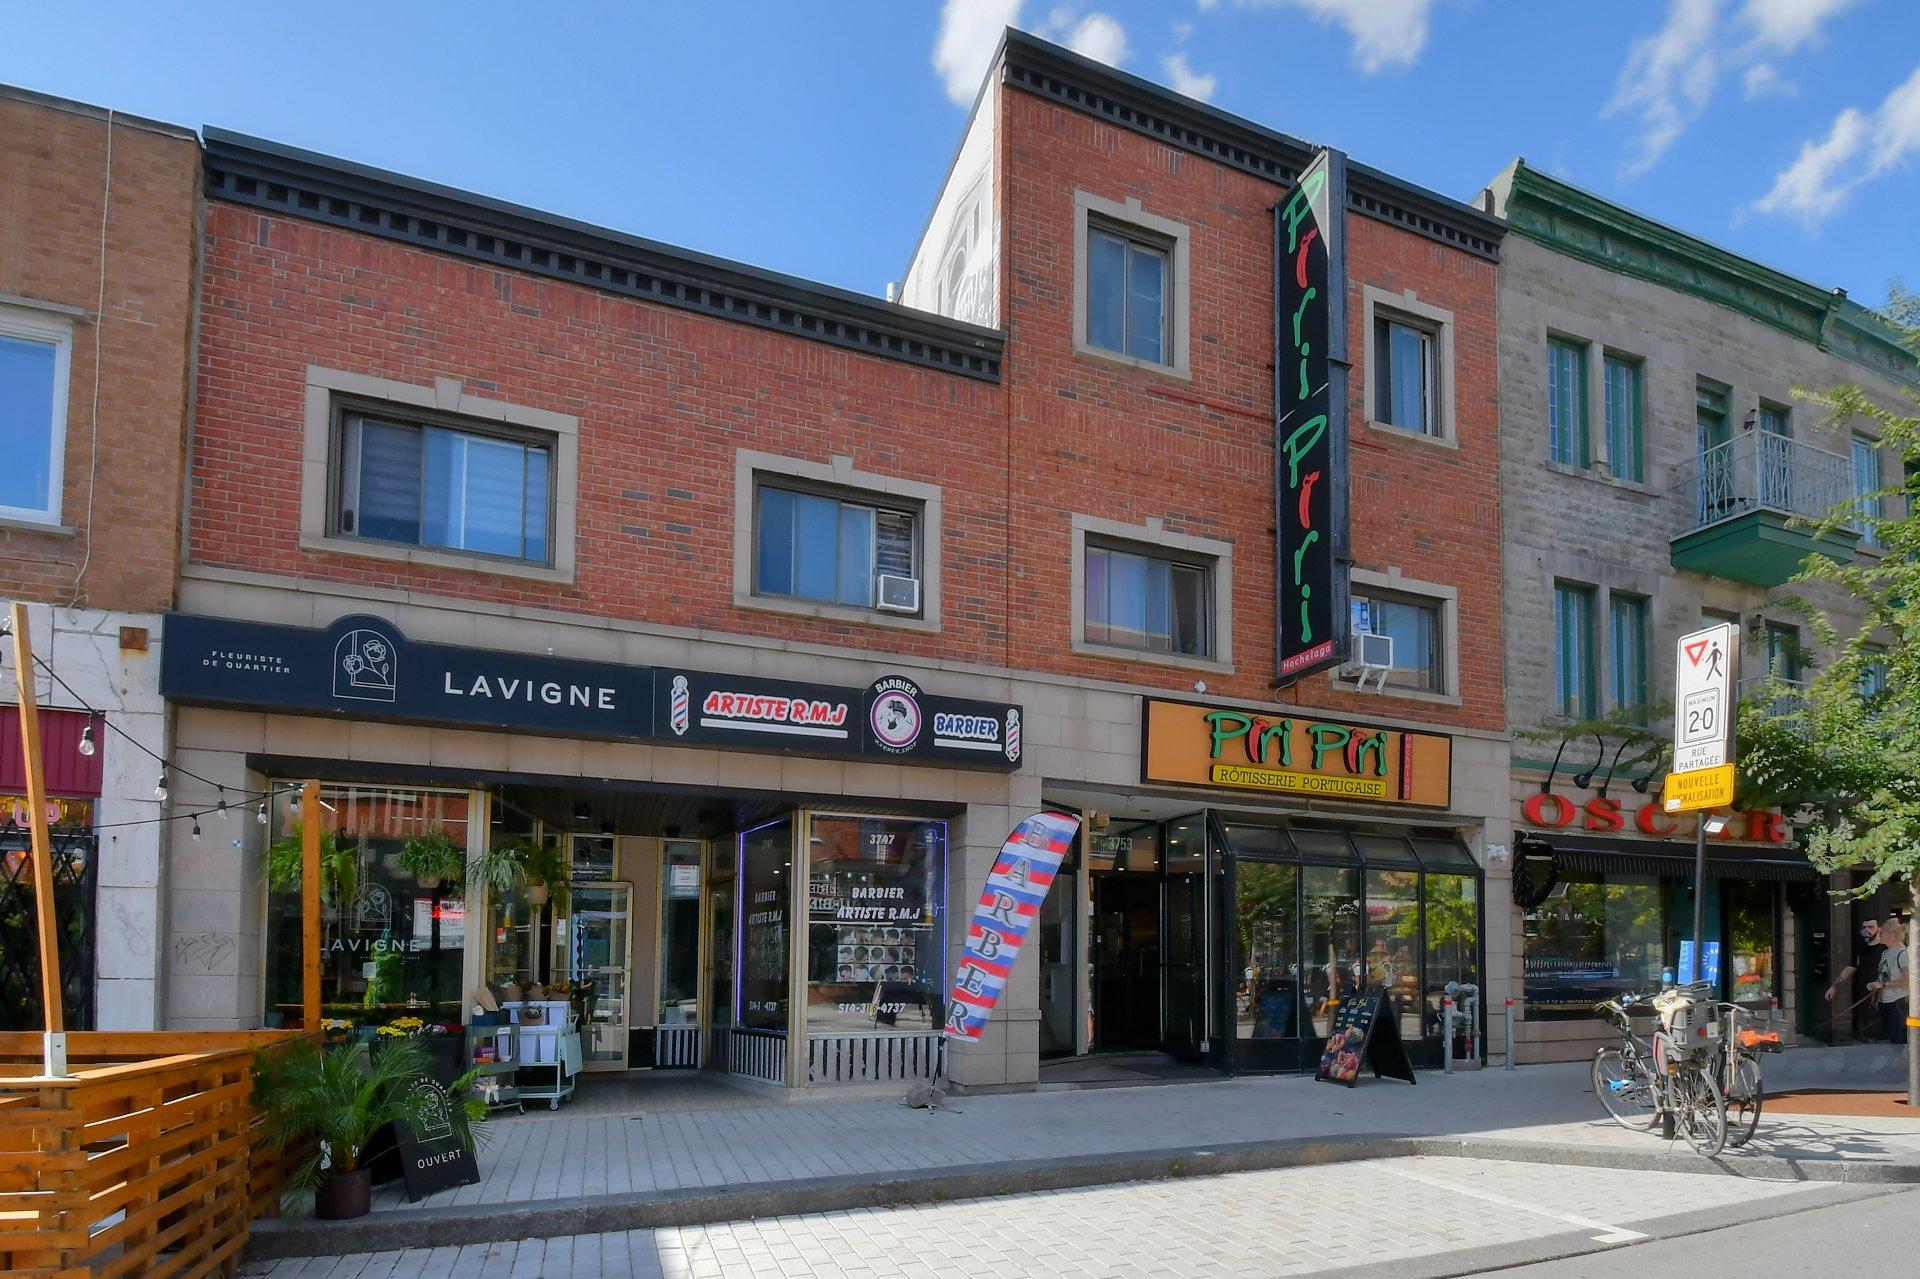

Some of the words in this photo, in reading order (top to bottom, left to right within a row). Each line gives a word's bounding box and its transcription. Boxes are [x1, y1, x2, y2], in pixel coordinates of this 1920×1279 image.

[1282, 170, 1324, 400] Piri
[1283, 415, 1327, 643] Piri
[203, 659, 218, 667] DE
[226, 661, 290, 674] QUARTIER
[212, 650, 282, 664] FLEURISTE
[1283, 645, 1331, 670] Hochelaga
[445, 672, 616, 710] LAVIGNE
[875, 679, 918, 697] BARBIER
[705, 692, 788, 719] ARTISTE
[792, 700, 846, 724] R.M.J
[1688, 695, 1715, 706] MAXIMUM
[935, 714, 998, 739] BARBIER
[1689, 707, 1714, 733] 20
[1205, 711, 1292, 767] Piri
[1305, 724, 1388, 776] Piri
[1691, 747, 1706, 757] RUE
[1679, 755, 1720, 771] PARTAGÉE
[1219, 767, 1296, 788] RÔTISSERIE
[1302, 777, 1381, 796] PORTUGAISE
[1677, 773, 1719, 790] NOUVELLE
[852, 887, 905, 900] BARBIER
[836, 906, 886, 920] ARTISTE
[888, 907, 920, 920] R.M.J
[946, 820, 1049, 1034] BARBER
[417, 1148, 461, 1169] OUVERT
